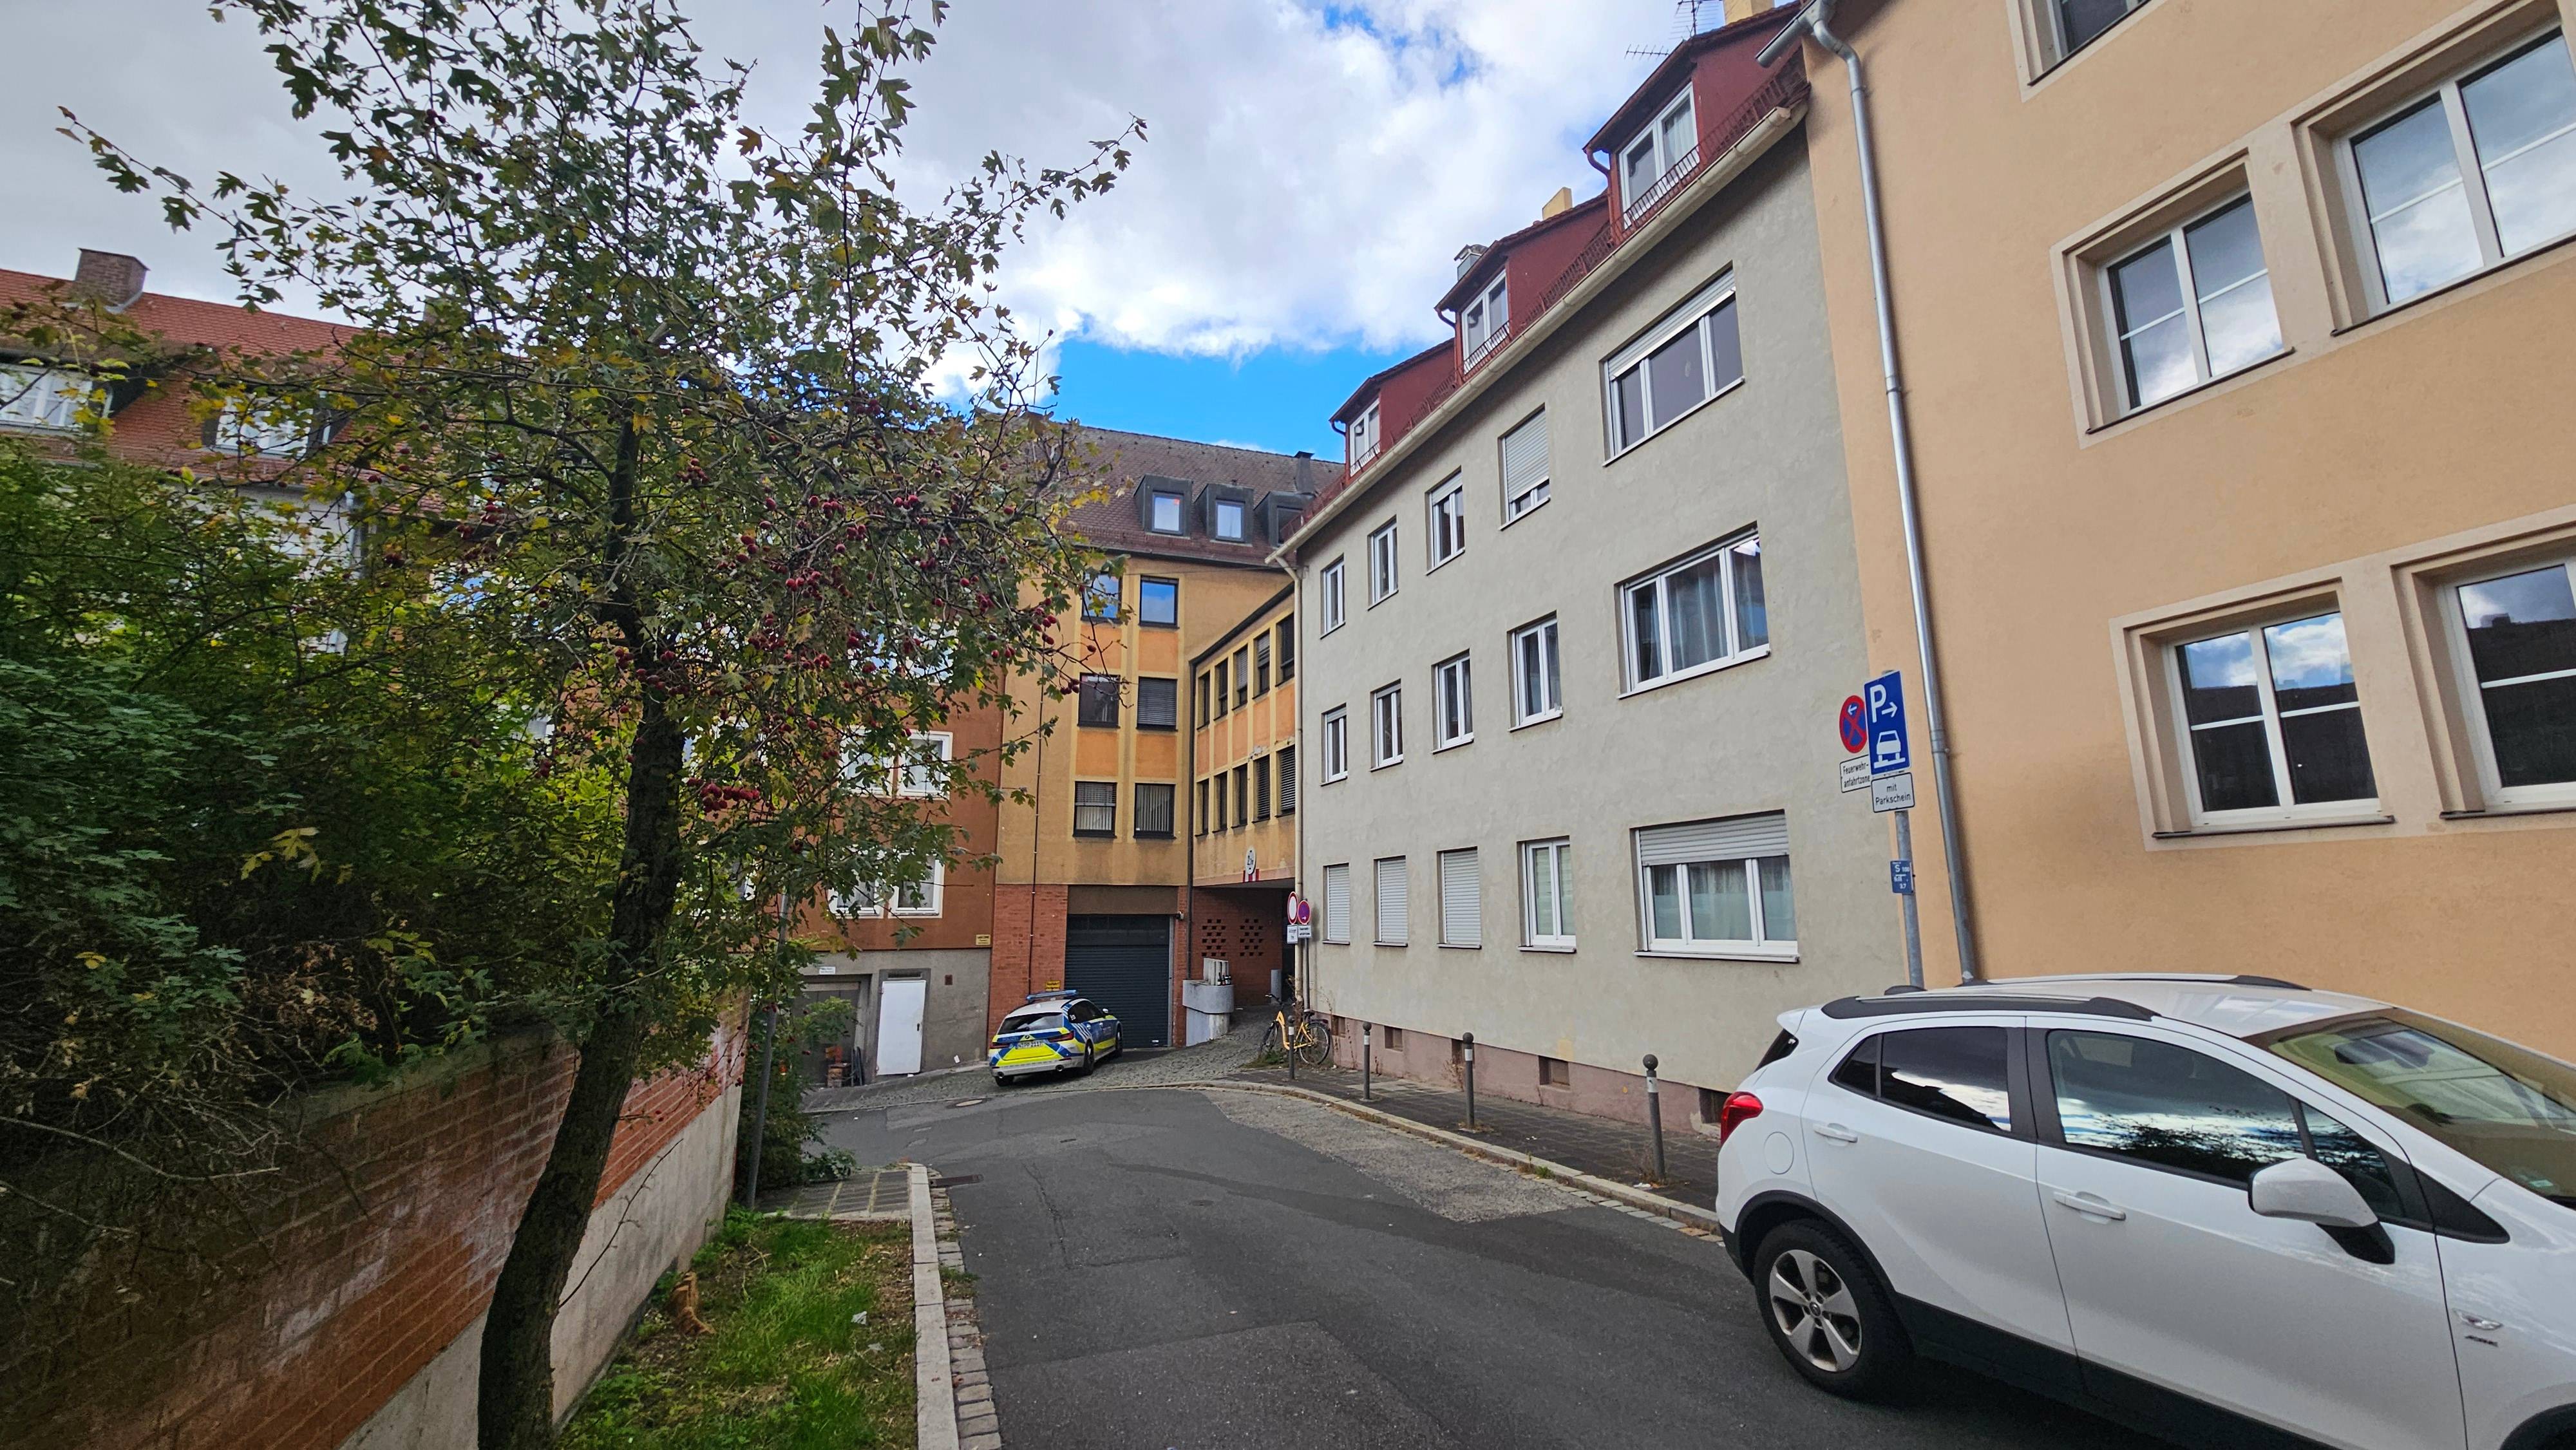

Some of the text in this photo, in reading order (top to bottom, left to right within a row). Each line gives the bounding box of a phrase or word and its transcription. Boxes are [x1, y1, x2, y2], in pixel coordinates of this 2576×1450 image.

[1869, 684, 1887, 723] P
[1843, 762, 1869, 775] Feuerwehr-
[1886, 784, 1897, 793] mit
[1875, 793, 1911, 805] Parkschein
[1895, 864, 1900, 872] S
